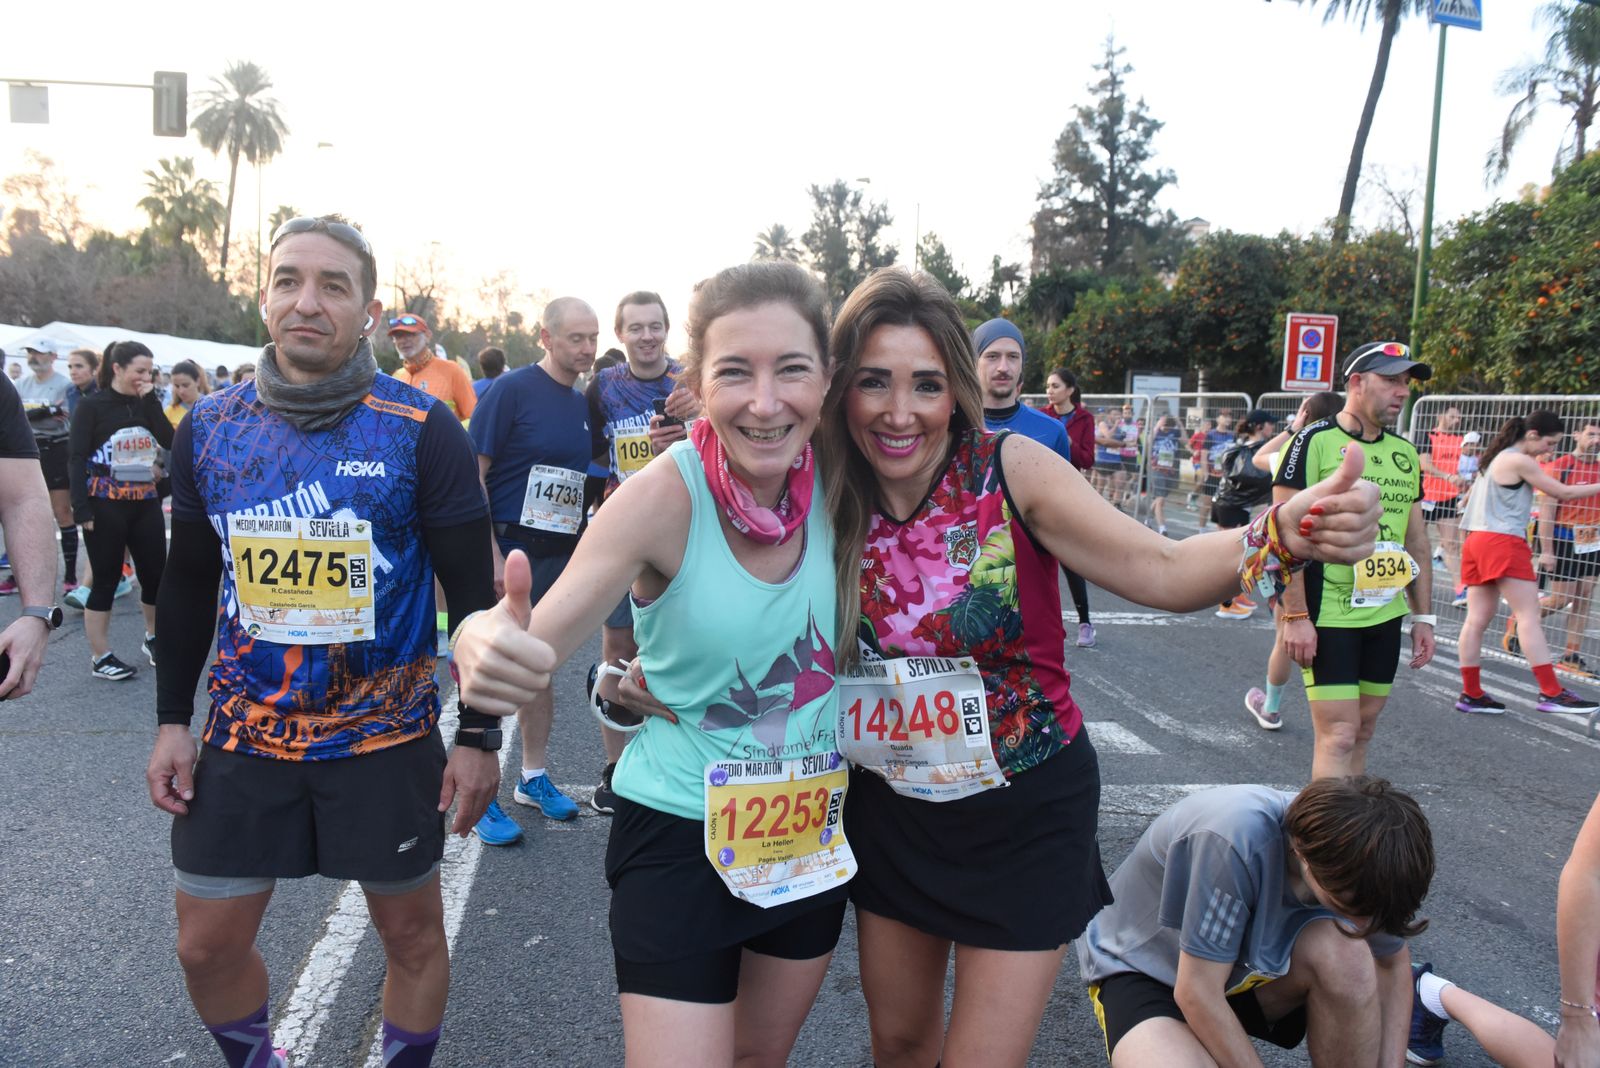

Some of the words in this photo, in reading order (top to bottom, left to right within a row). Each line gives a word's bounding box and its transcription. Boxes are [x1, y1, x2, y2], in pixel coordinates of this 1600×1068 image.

[116, 436, 152, 452] 14156
[335, 460, 386, 478] HOKA
[534, 480, 579, 506] 14733
[236, 519, 257, 532] MEDIO
[258, 518, 292, 533] MARATÓN
[309, 520, 350, 538] SEVILLA
[241, 547, 348, 587] 12475
[1365, 557, 1407, 578] 9534
[288, 629, 308, 637] HOKA
[907, 657, 957, 678] SEVILLA
[848, 690, 960, 742] 14248
[745, 759, 783, 777] MARATÓN
[802, 752, 834, 776] SEVILL
[720, 786, 829, 841] 12253
[770, 885, 790, 897] HOKA
